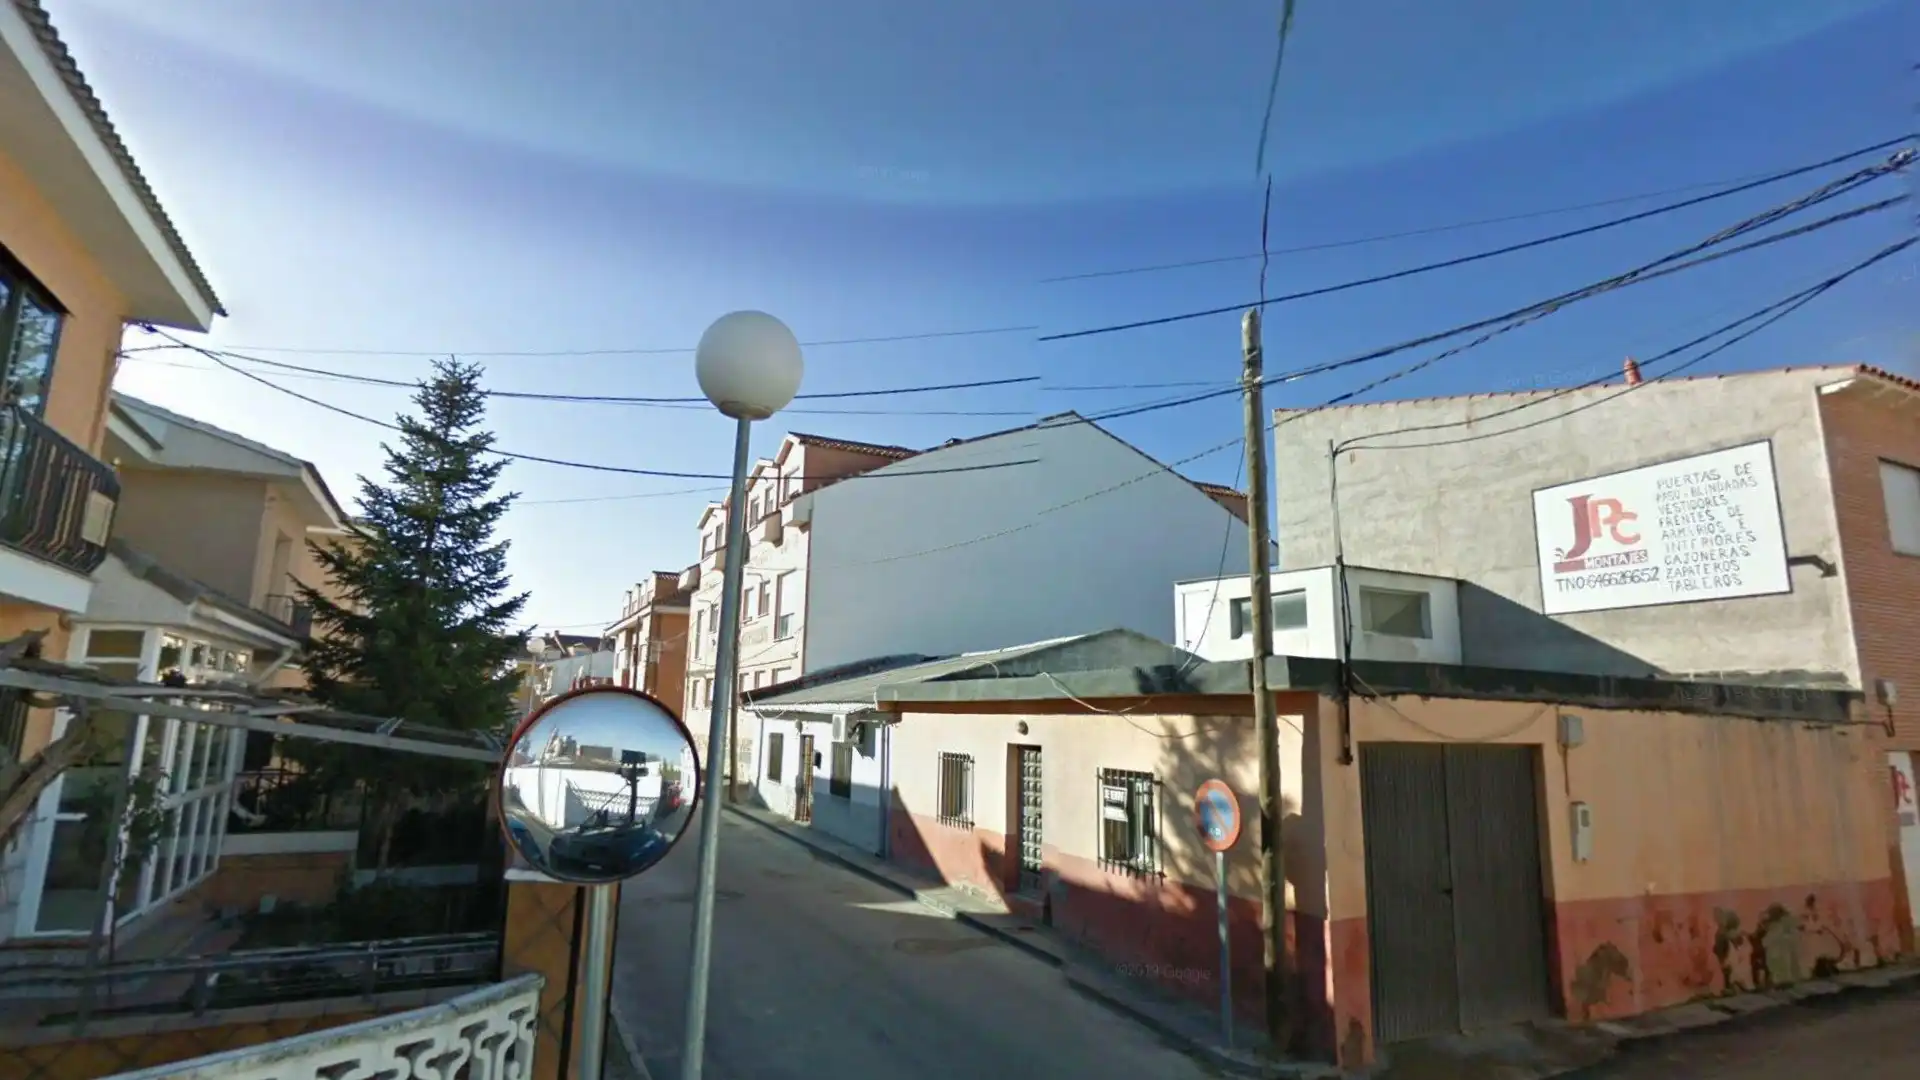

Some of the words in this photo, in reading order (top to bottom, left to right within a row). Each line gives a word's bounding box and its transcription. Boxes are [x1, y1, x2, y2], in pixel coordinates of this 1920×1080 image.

[1656, 468, 1721, 489] PUERTAS
[1733, 462, 1752, 476] DE
[1691, 476, 1758, 497] BLINDADAS
[1657, 495, 1728, 515] VESTIDORES
[1659, 509, 1715, 527] FRENTES
[1727, 505, 1744, 518] DE
[1665, 530, 1757, 553] INTERIORES
[1585, 549, 1648, 569] MONTAJES
[1664, 545, 1751, 565] CAJONERAS
[1667, 560, 1740, 578] ZAPATEROS
[1668, 573, 1743, 592] TABLEROS
